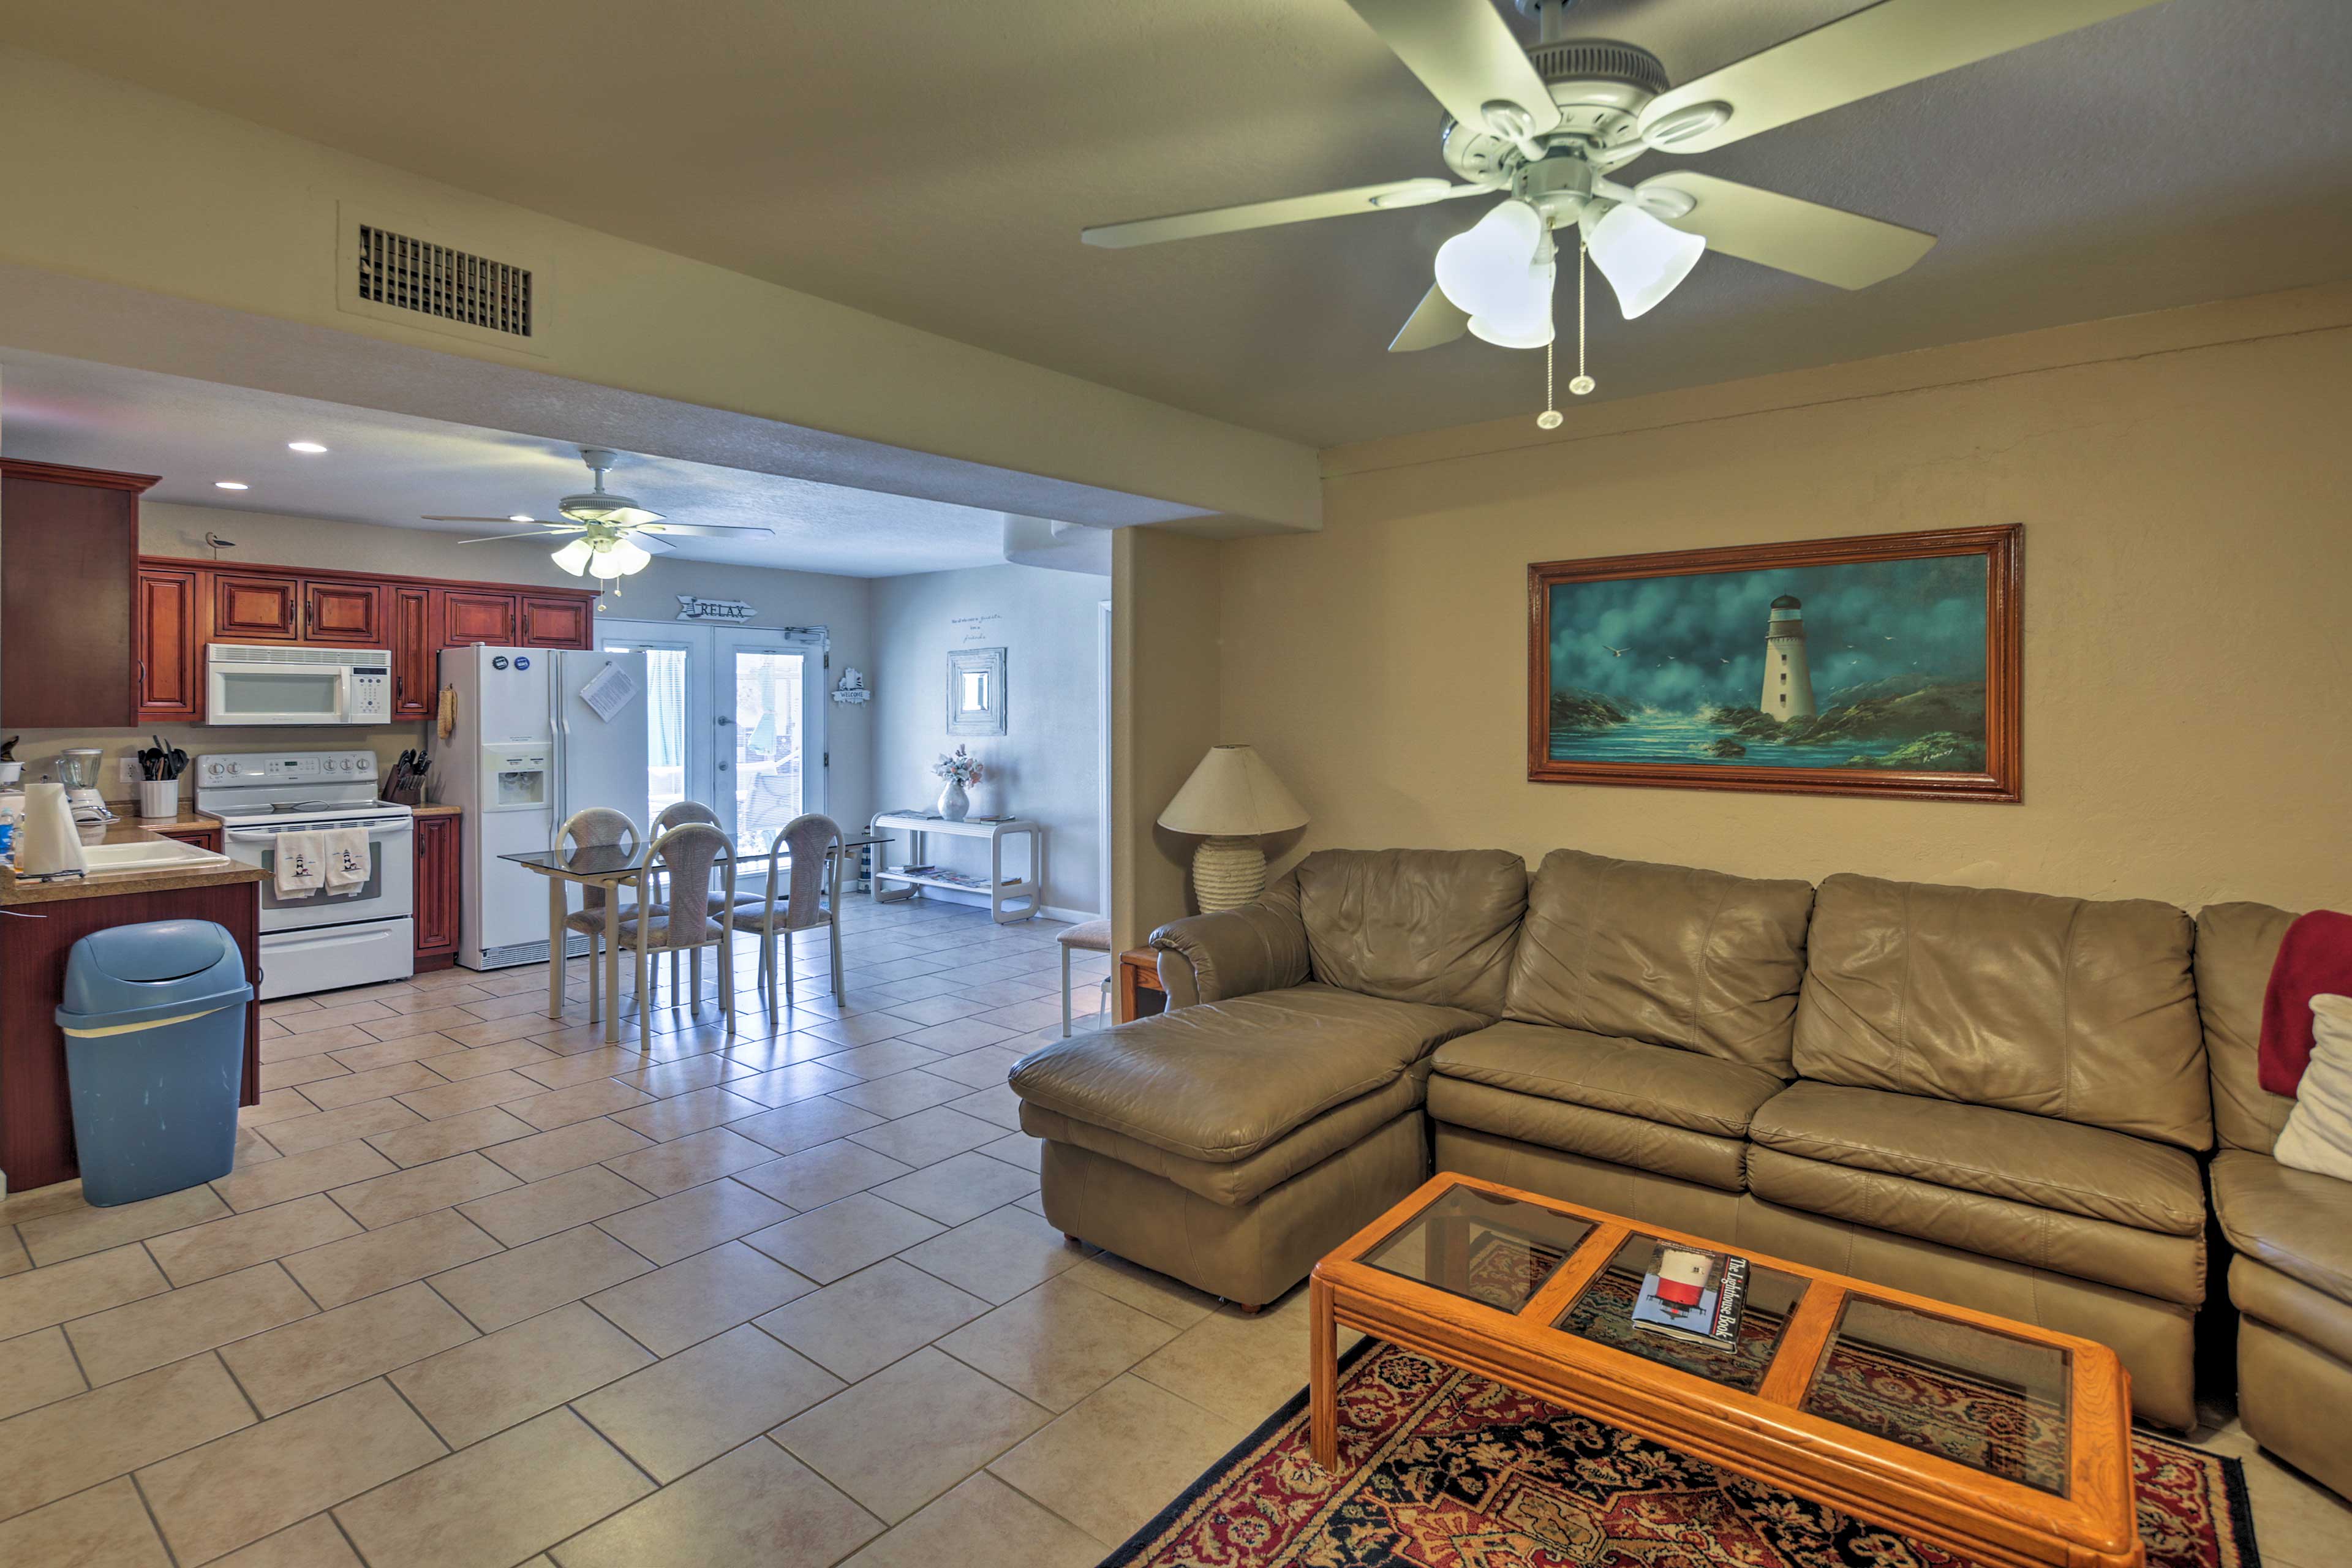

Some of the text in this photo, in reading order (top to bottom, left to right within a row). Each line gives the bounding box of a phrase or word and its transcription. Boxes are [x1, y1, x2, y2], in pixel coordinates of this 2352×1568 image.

[701, 603, 744, 618] RELAX
[1715, 1258, 1746, 1340] The Lighthouse Book
